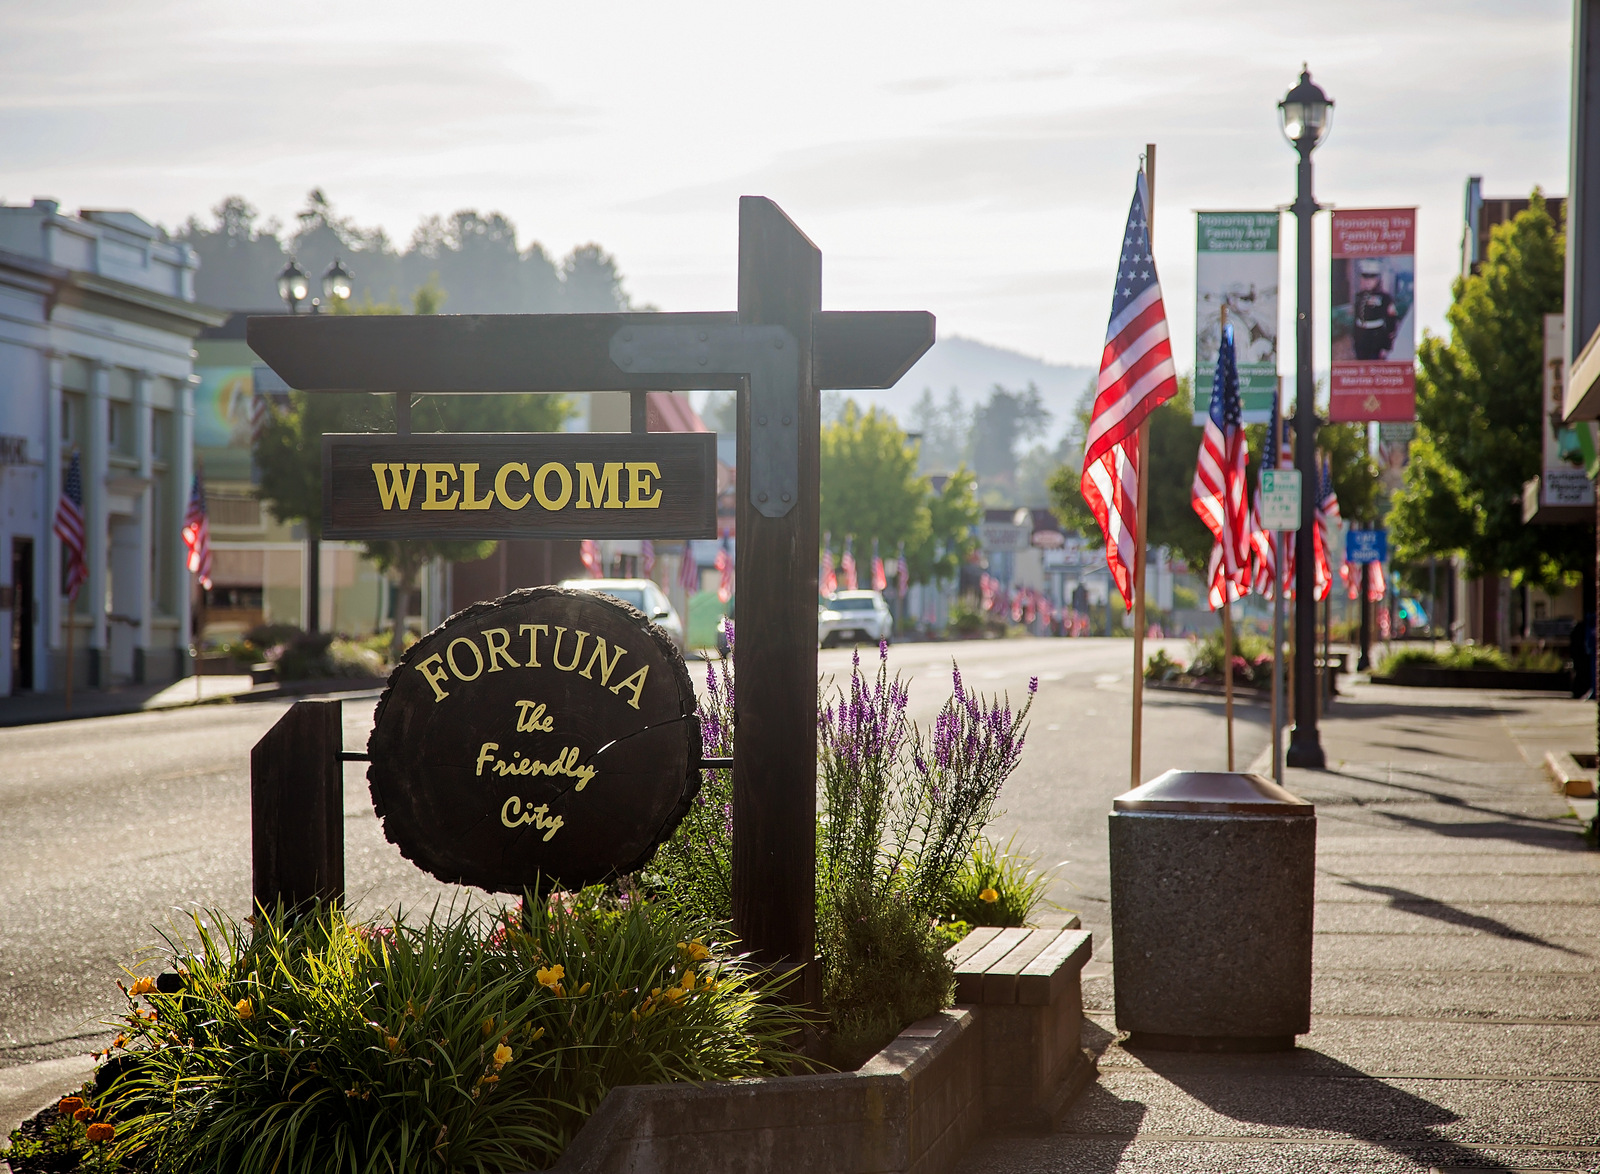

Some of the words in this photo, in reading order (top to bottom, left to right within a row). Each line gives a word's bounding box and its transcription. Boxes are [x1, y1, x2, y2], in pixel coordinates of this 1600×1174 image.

[1201, 215, 1254, 228] Honoring
[1256, 215, 1276, 226] the
[1335, 217, 1389, 230] Honoring
[1391, 216, 1411, 228] the
[1206, 228, 1245, 240] Family
[1246, 227, 1271, 239] And
[1340, 229, 1379, 242] Family
[1382, 229, 1406, 240] And
[1209, 239, 1252, 250] Service
[1254, 239, 1267, 250] of
[1343, 241, 1388, 252] Service
[1389, 241, 1402, 251] of
[1341, 376, 1373, 386] Marine
[371, 461, 663, 511] WELCOME
[1264, 474, 1273, 490] 2
[415, 623, 651, 710] FORTUNA
[515, 700, 554, 733] The
[476, 743, 596, 792] Friendly
[501, 796, 565, 842] City
